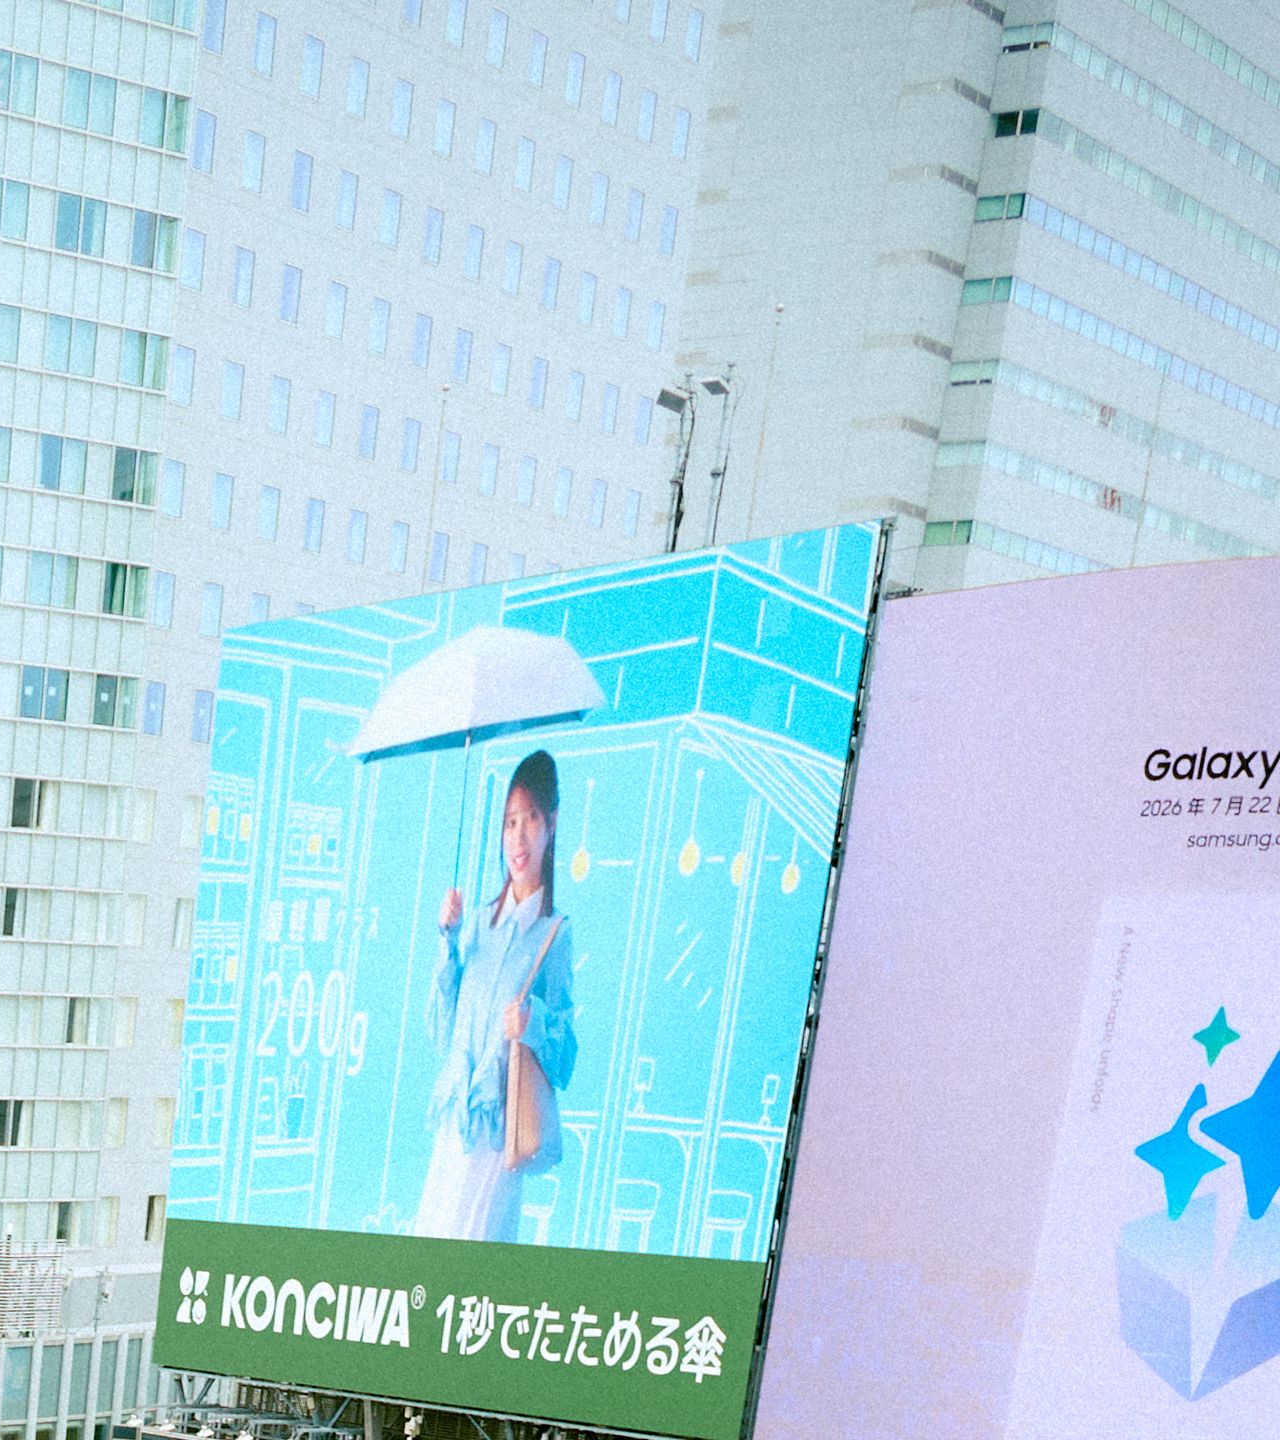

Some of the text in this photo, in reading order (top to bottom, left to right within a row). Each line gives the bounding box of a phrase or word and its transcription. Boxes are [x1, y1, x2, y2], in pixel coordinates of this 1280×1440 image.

[1144, 746, 1280, 789] Galaxy
[436, 1294, 727, 1384] 1秒でたためる傘
